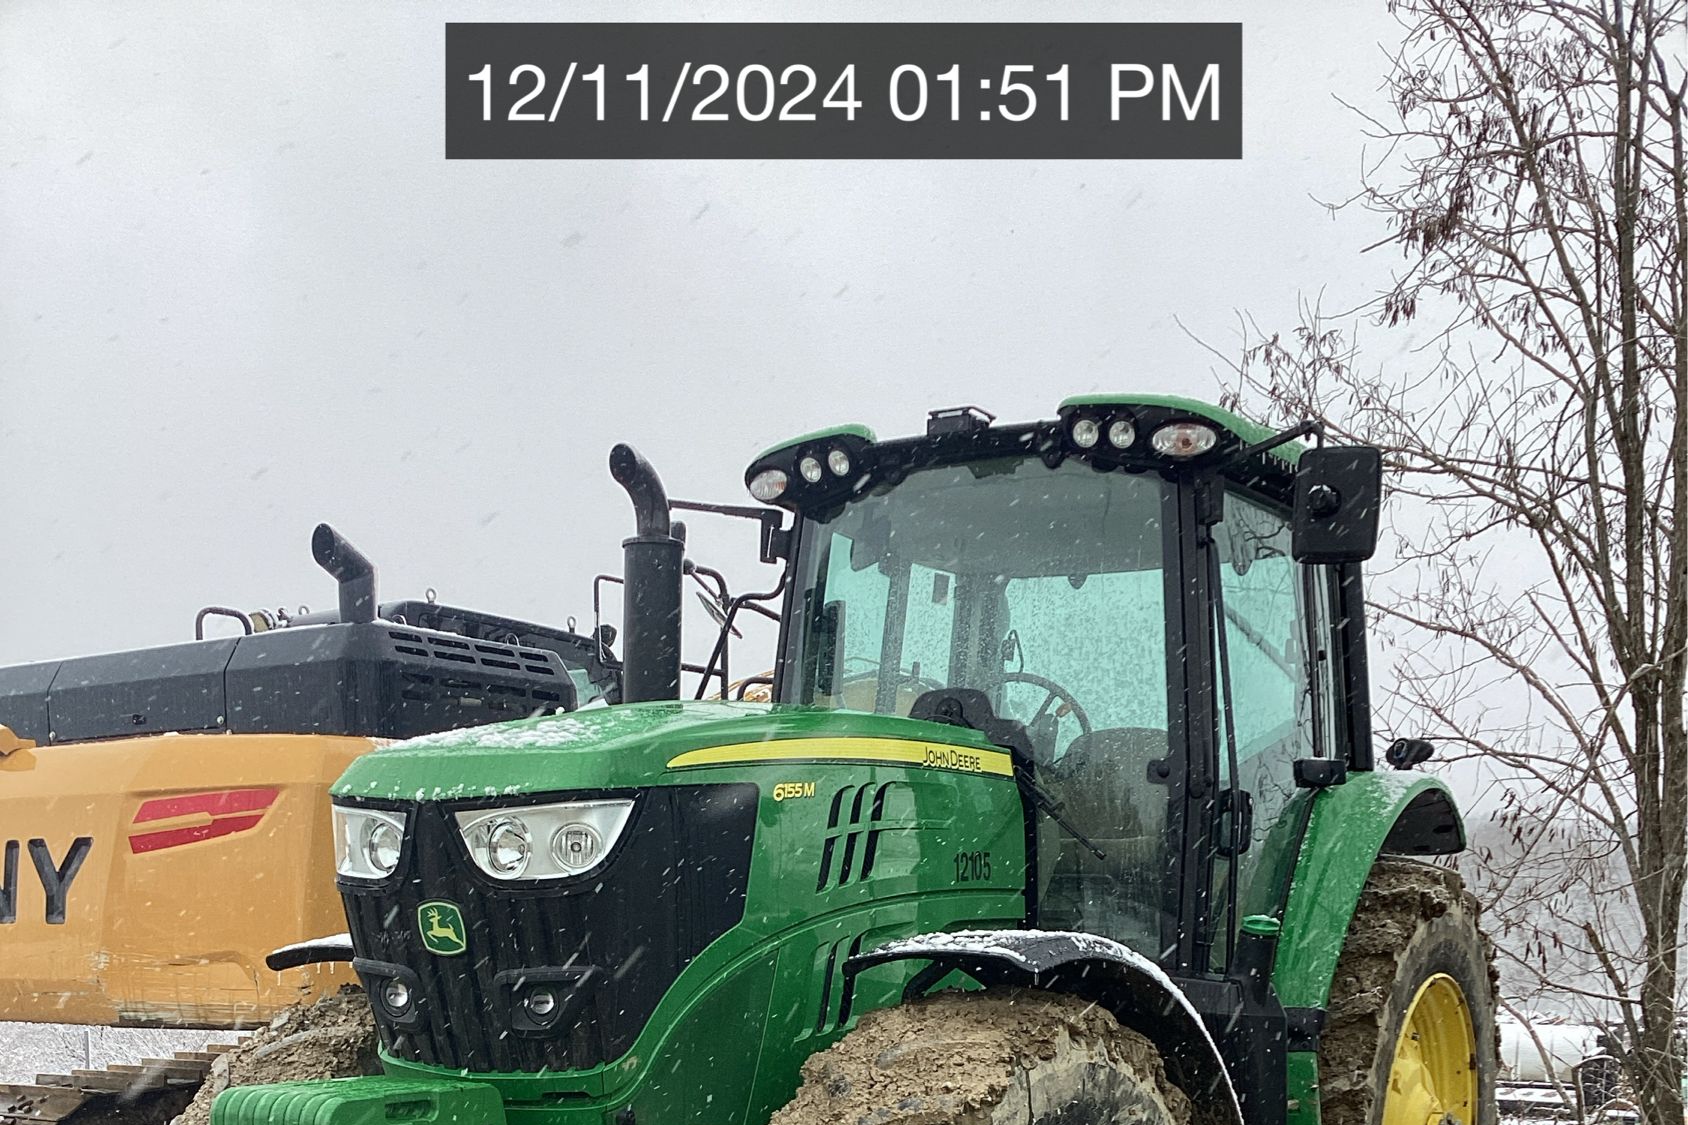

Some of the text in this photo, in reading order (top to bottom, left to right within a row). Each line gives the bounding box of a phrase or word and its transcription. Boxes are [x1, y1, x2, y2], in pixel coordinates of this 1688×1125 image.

[922, 745, 981, 771] JOHN DEERE
[953, 850, 991, 883] 12105
